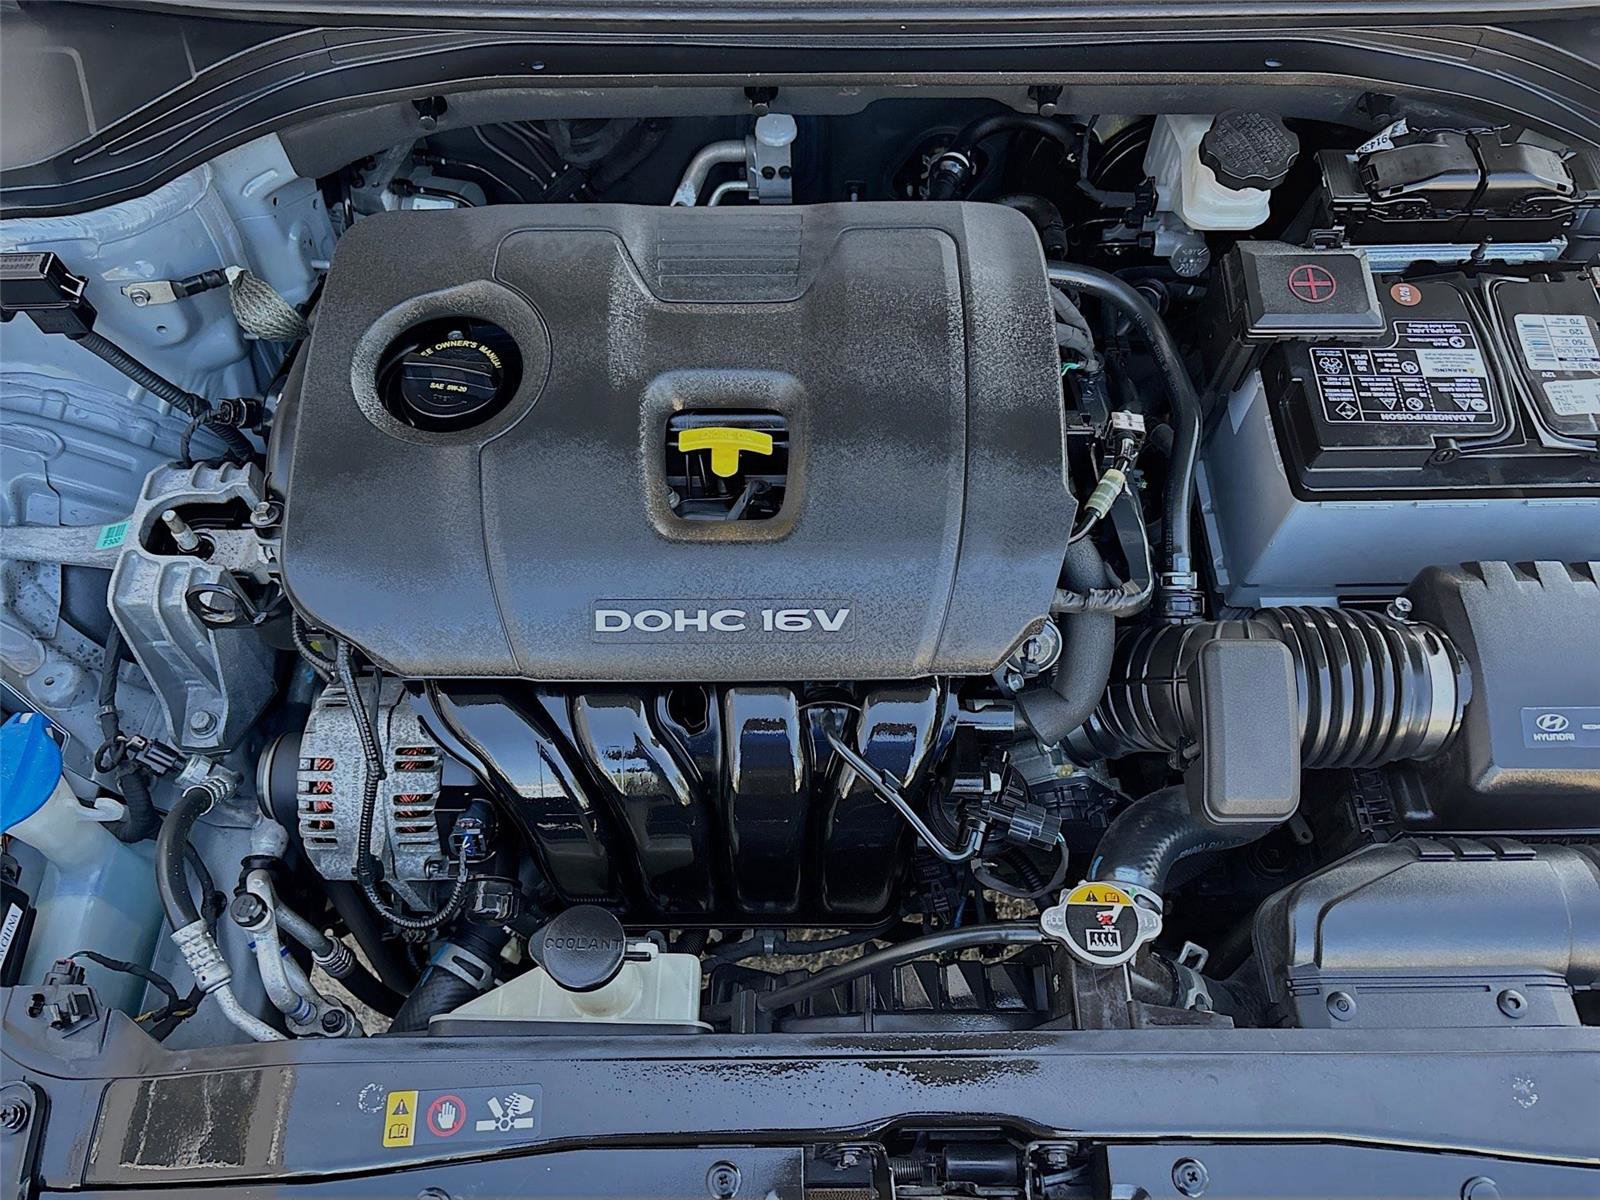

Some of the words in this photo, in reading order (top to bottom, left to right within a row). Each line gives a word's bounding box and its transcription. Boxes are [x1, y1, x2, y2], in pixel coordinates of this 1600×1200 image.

[435, 340, 478, 350] OWNER'S
[429, 382, 445, 390] SAE
[595, 609, 746, 632] DOHC
[761, 609, 850, 632] 16V
[1533, 733, 1576, 741] HYUNDAI
[544, 937, 623, 951] COOLANT
